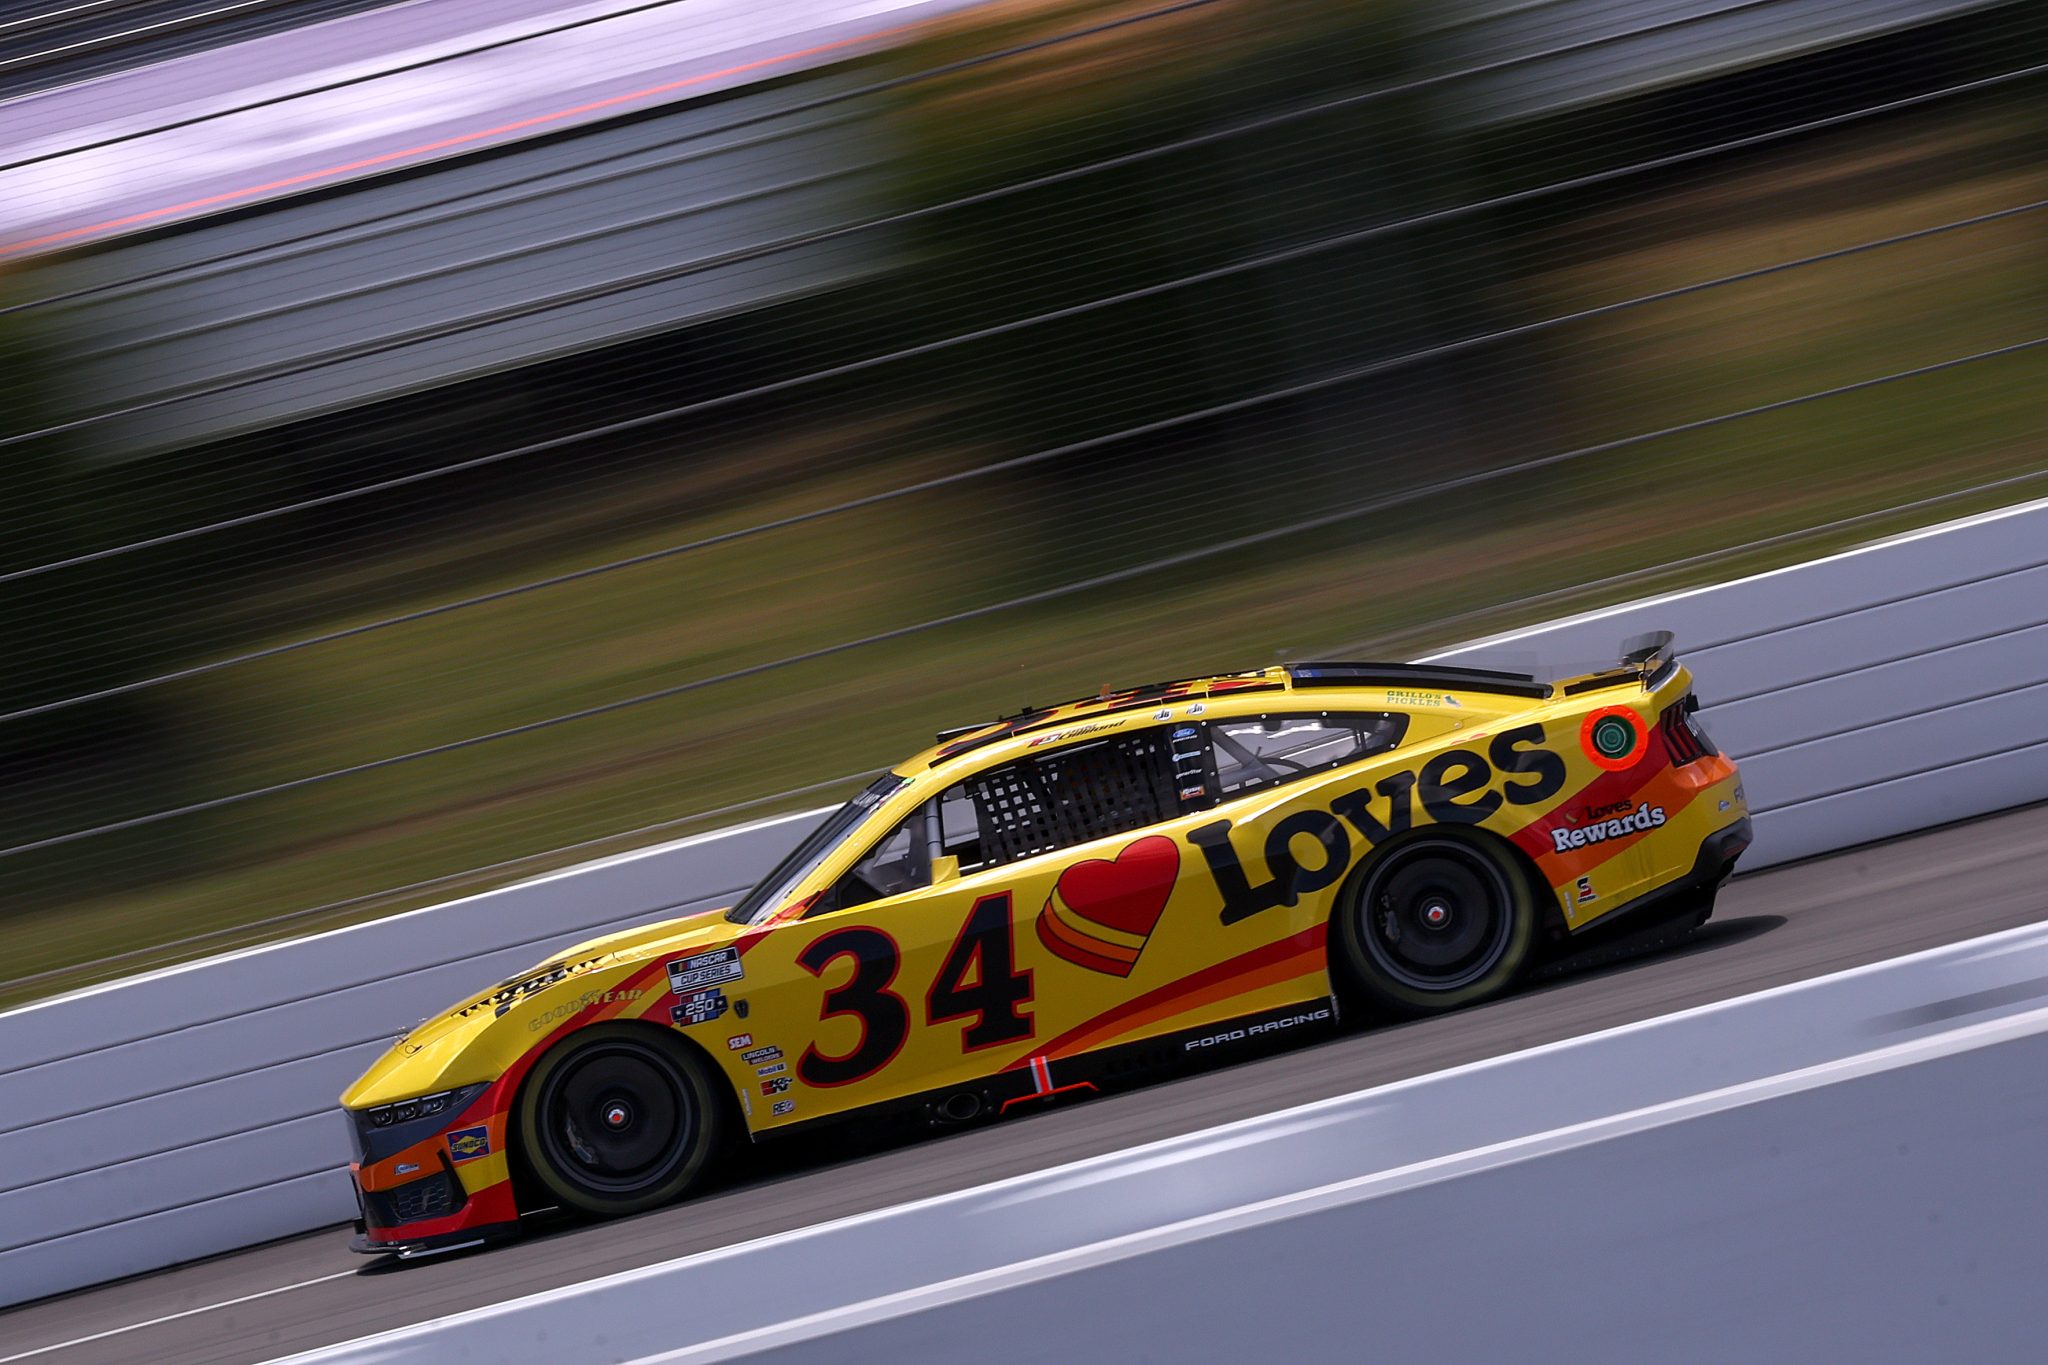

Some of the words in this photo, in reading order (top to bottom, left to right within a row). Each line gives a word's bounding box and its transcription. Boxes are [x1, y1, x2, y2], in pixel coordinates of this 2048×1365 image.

[1386, 697, 1441, 707] PICKLES
[1387, 690, 1441, 699] GRILLO'S
[1551, 802, 1667, 852] Rewards
[690, 952, 728, 969] NASCAR
[680, 973, 699, 985] CUP
[699, 965, 731, 980] SERIES
[794, 890, 1036, 1089] 34
[528, 988, 645, 1032] GOODYEAR
[685, 998, 715, 1016] 250
[1184, 1029, 1246, 1051] FORD
[1248, 1008, 1330, 1036] RACING
[728, 1034, 752, 1050] SEM
[742, 1046, 776, 1060] LINCOLN
[452, 1136, 488, 1151] SUNOCO
